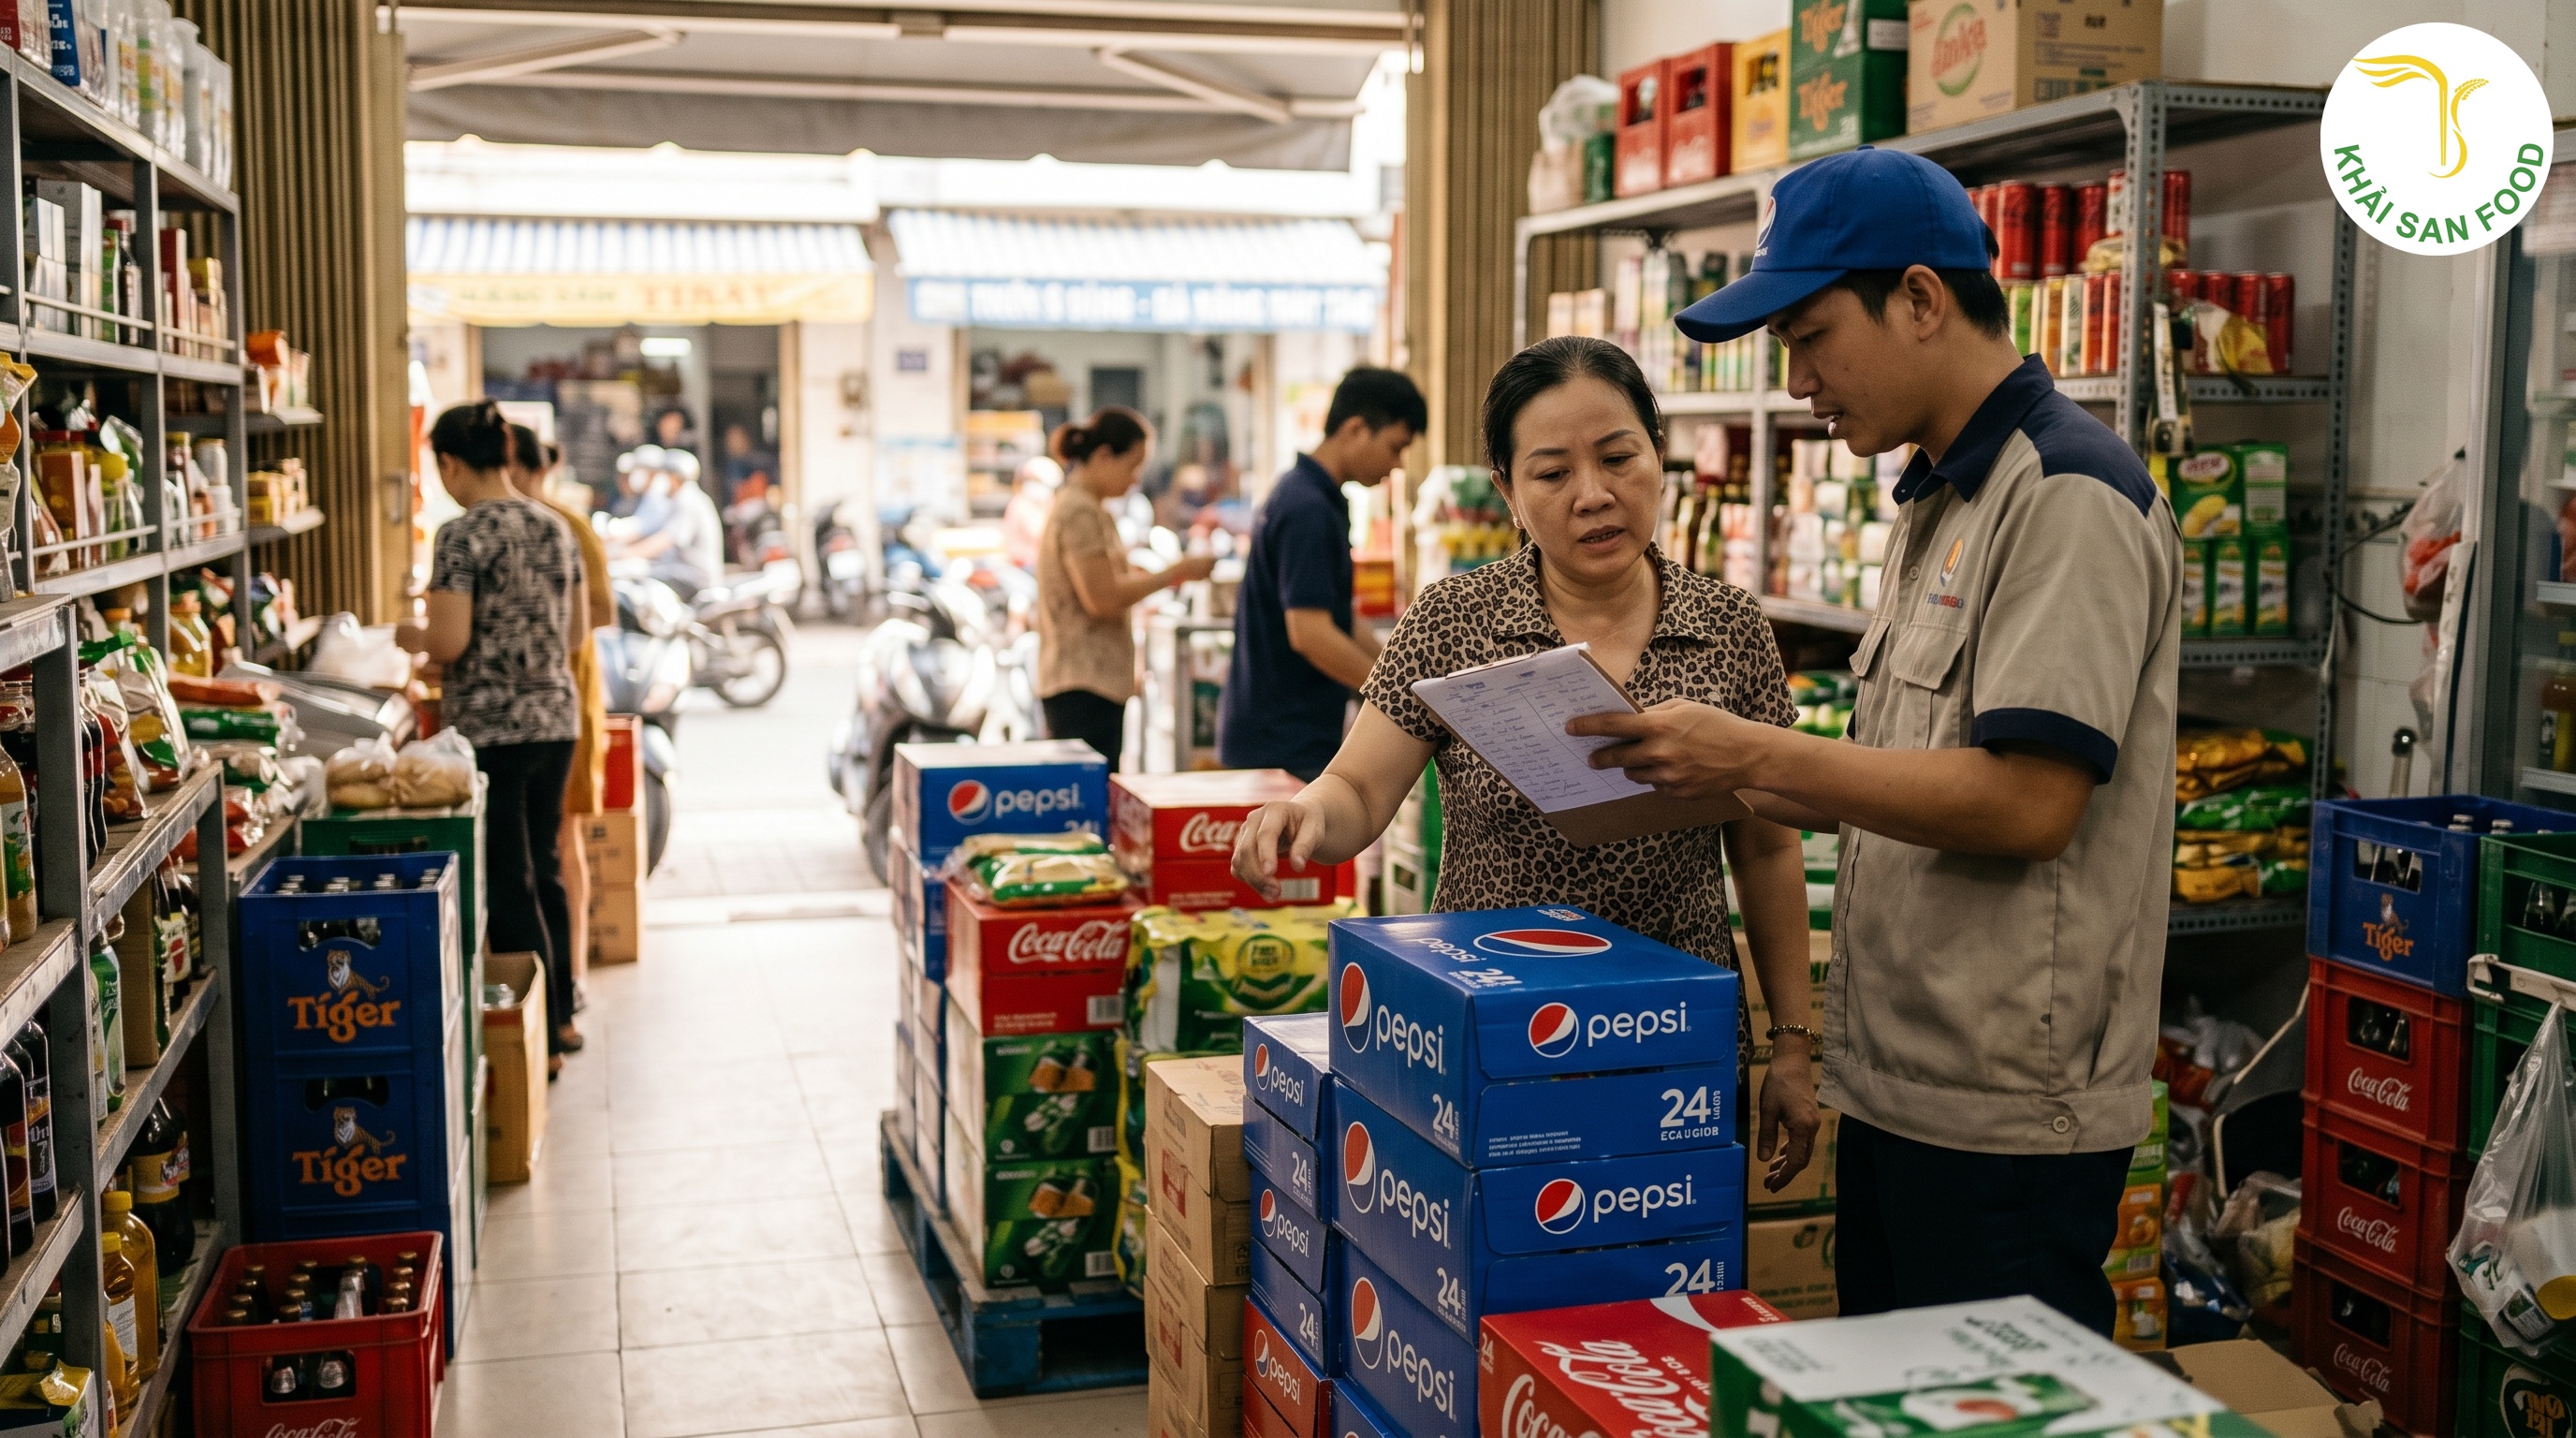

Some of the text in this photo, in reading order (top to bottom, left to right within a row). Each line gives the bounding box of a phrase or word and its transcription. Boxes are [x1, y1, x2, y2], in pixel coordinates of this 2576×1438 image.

[995, 782, 1079, 819] pepsi
[1402, 937, 1486, 962] pepsi
[2362, 921, 2414, 962] Tiger
[287, 990, 402, 1044] Tiger
[1377, 1005, 1443, 1074] pepsi
[1588, 1001, 1687, 1047] pepsi
[1270, 1065, 1304, 1107] pepsi
[1660, 1086, 1711, 1128] 24
[1432, 1093, 1456, 1139] 24
[291, 1144, 407, 1197] Tiger
[1292, 1152, 1308, 1193] 24
[1381, 1168, 1450, 1248] pepsi
[1594, 1174, 1691, 1223] pepsi
[1277, 1213, 1309, 1257] pepsi
[1437, 1268, 1461, 1316] 24
[1664, 1258, 1716, 1298] 24
[1299, 1302, 1315, 1346] 24
[1270, 1356, 1301, 1405] pepsi
[1387, 1329, 1454, 1419] pepsi
